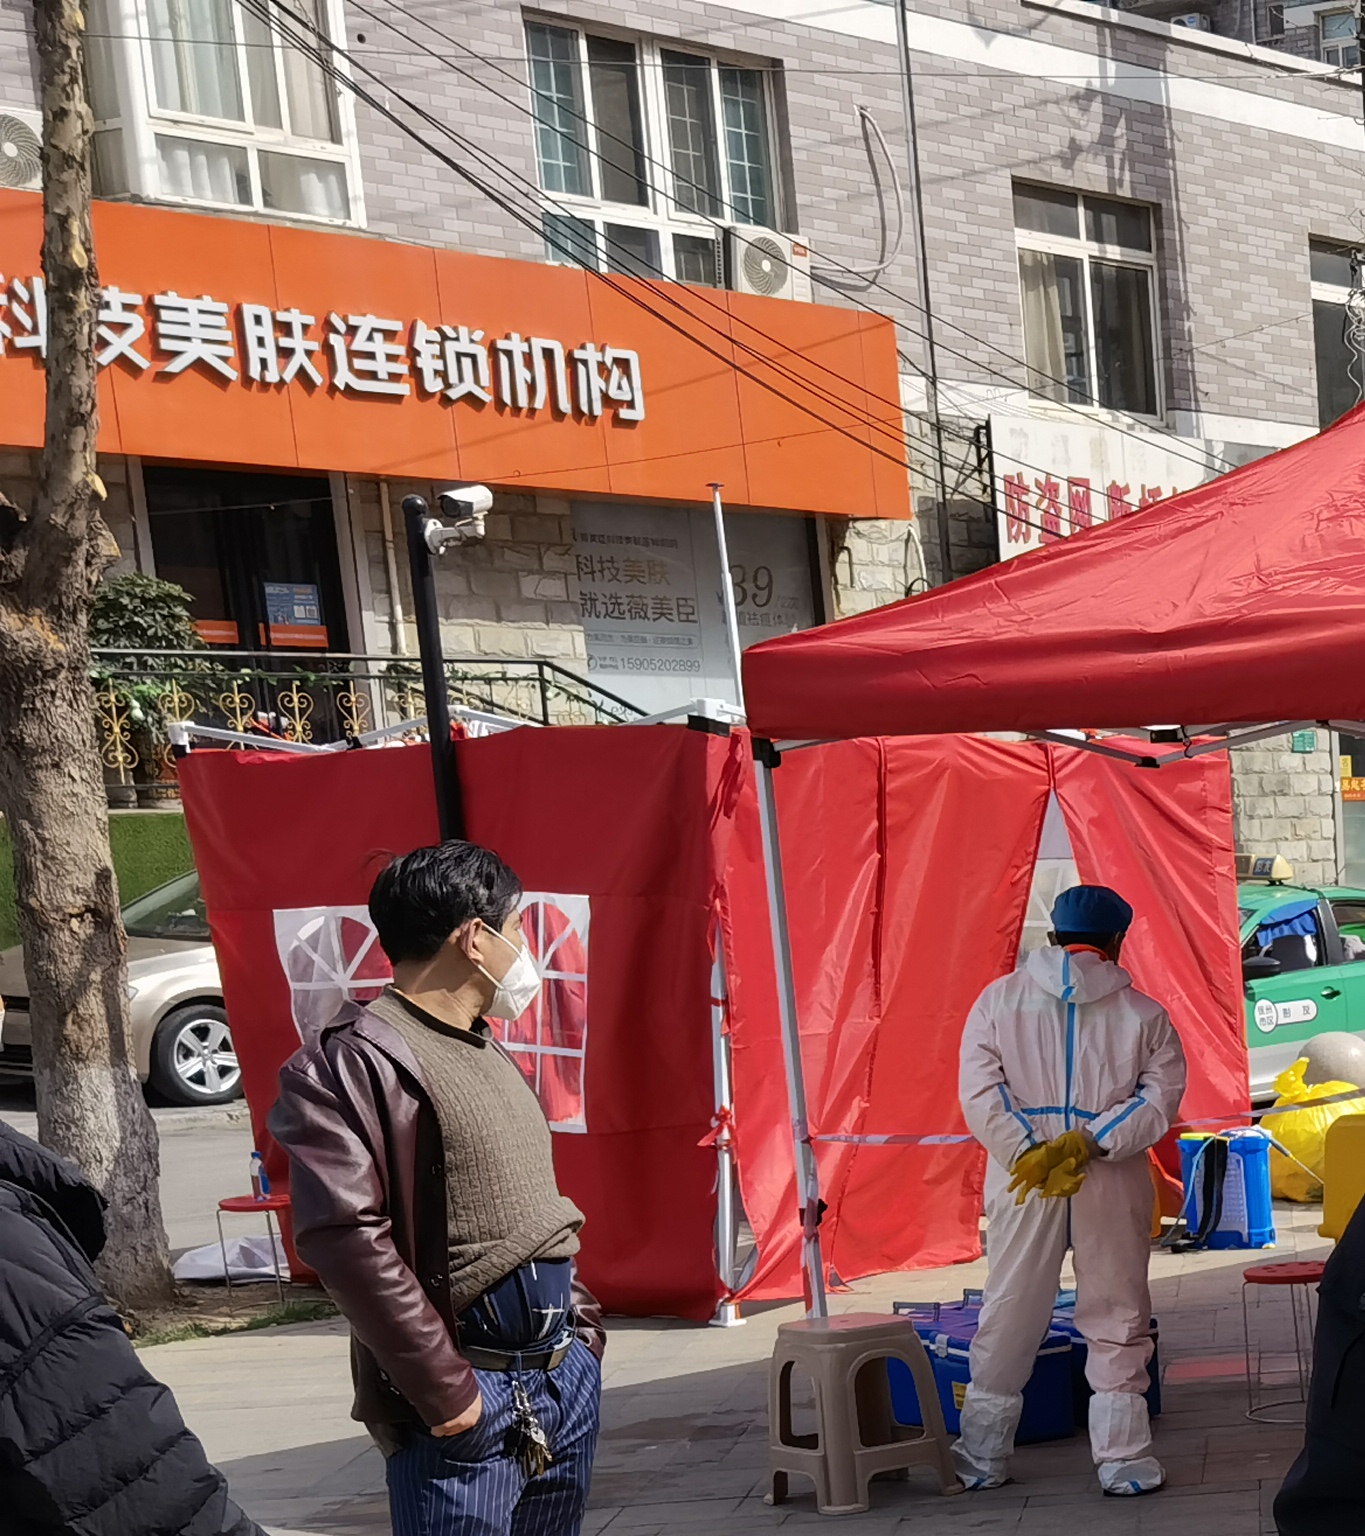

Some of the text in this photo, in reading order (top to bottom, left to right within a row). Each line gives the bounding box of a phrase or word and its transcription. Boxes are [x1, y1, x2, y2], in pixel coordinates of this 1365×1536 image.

[576, 554, 671, 586] 科技美肤
[579, 591, 699, 624] 就选薇美臣
[620, 657, 701, 673] 15905202899
